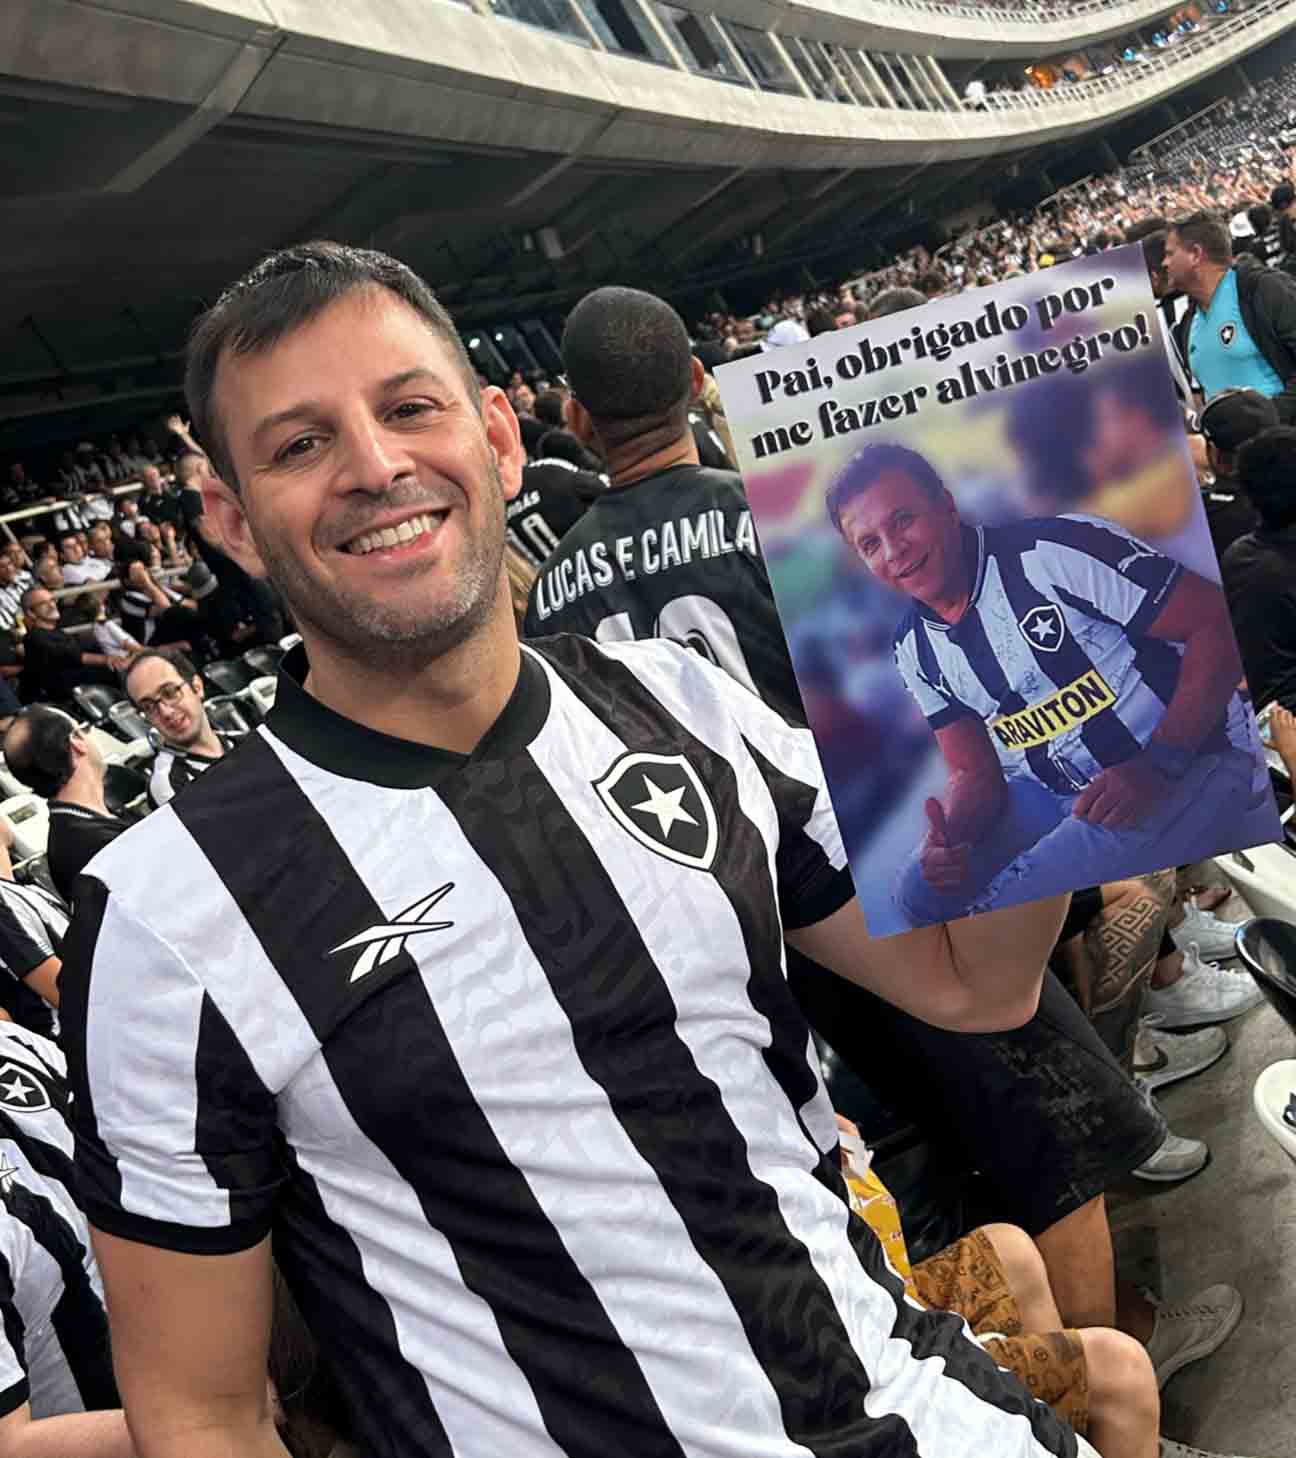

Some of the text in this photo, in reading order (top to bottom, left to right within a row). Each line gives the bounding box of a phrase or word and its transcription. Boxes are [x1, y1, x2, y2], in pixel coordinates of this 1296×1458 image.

[751, 314, 1151, 459] me fazer alvinegro!
[754, 278, 1115, 405] Pai, obrigado por
[536, 509, 757, 620] LUCAS E CAMILA
